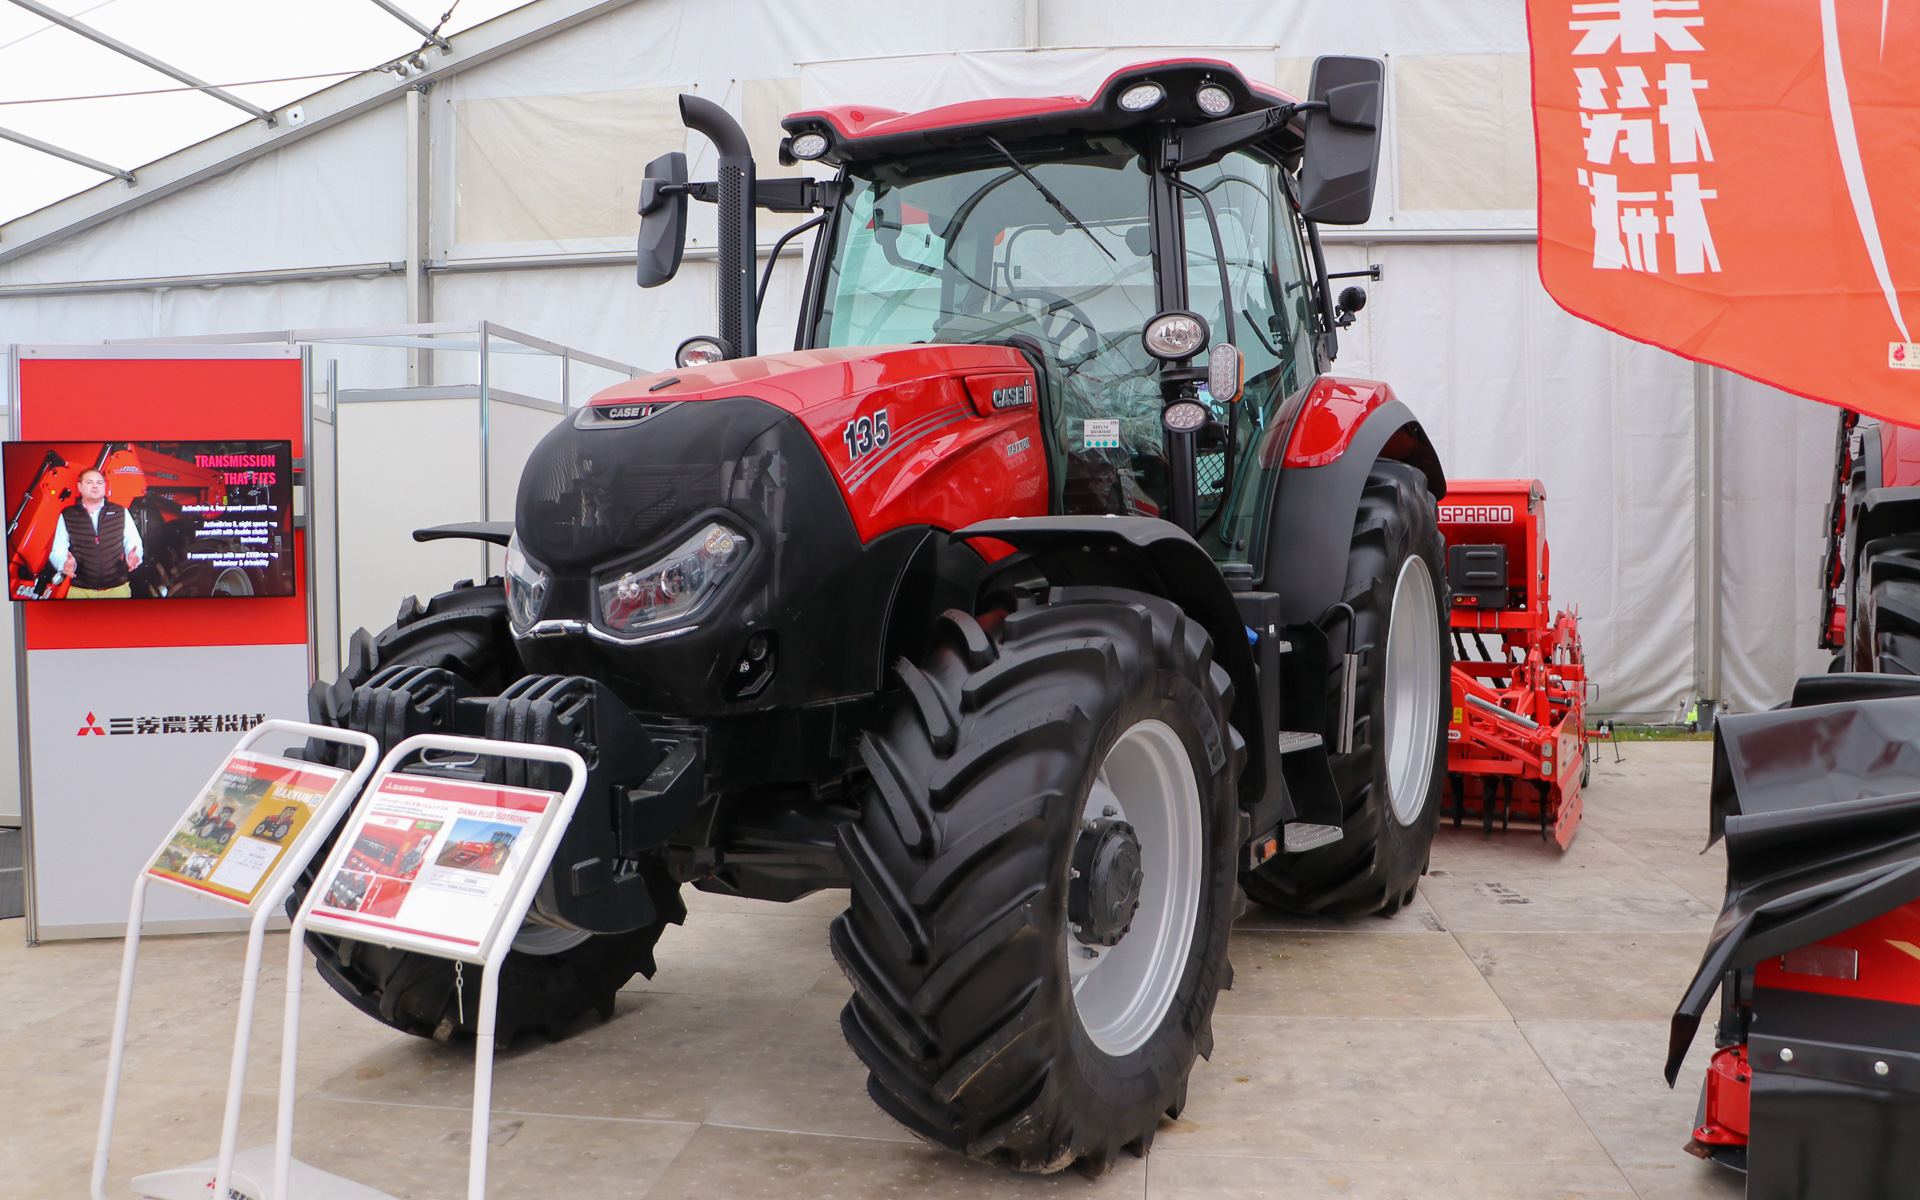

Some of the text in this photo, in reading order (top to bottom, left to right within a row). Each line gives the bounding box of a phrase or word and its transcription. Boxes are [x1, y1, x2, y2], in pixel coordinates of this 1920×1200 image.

[609, 407, 640, 418] CASE
[843, 408, 891, 461] 135
[194, 454, 276, 467] TRANSMISSION
[223, 472, 277, 485] THAT FITS
[110, 713, 266, 735] 三菱農業機械
[272, 786, 314, 803] MAXXUM
[457, 807, 531, 824] DAMA PLUS ISOTRONIC
